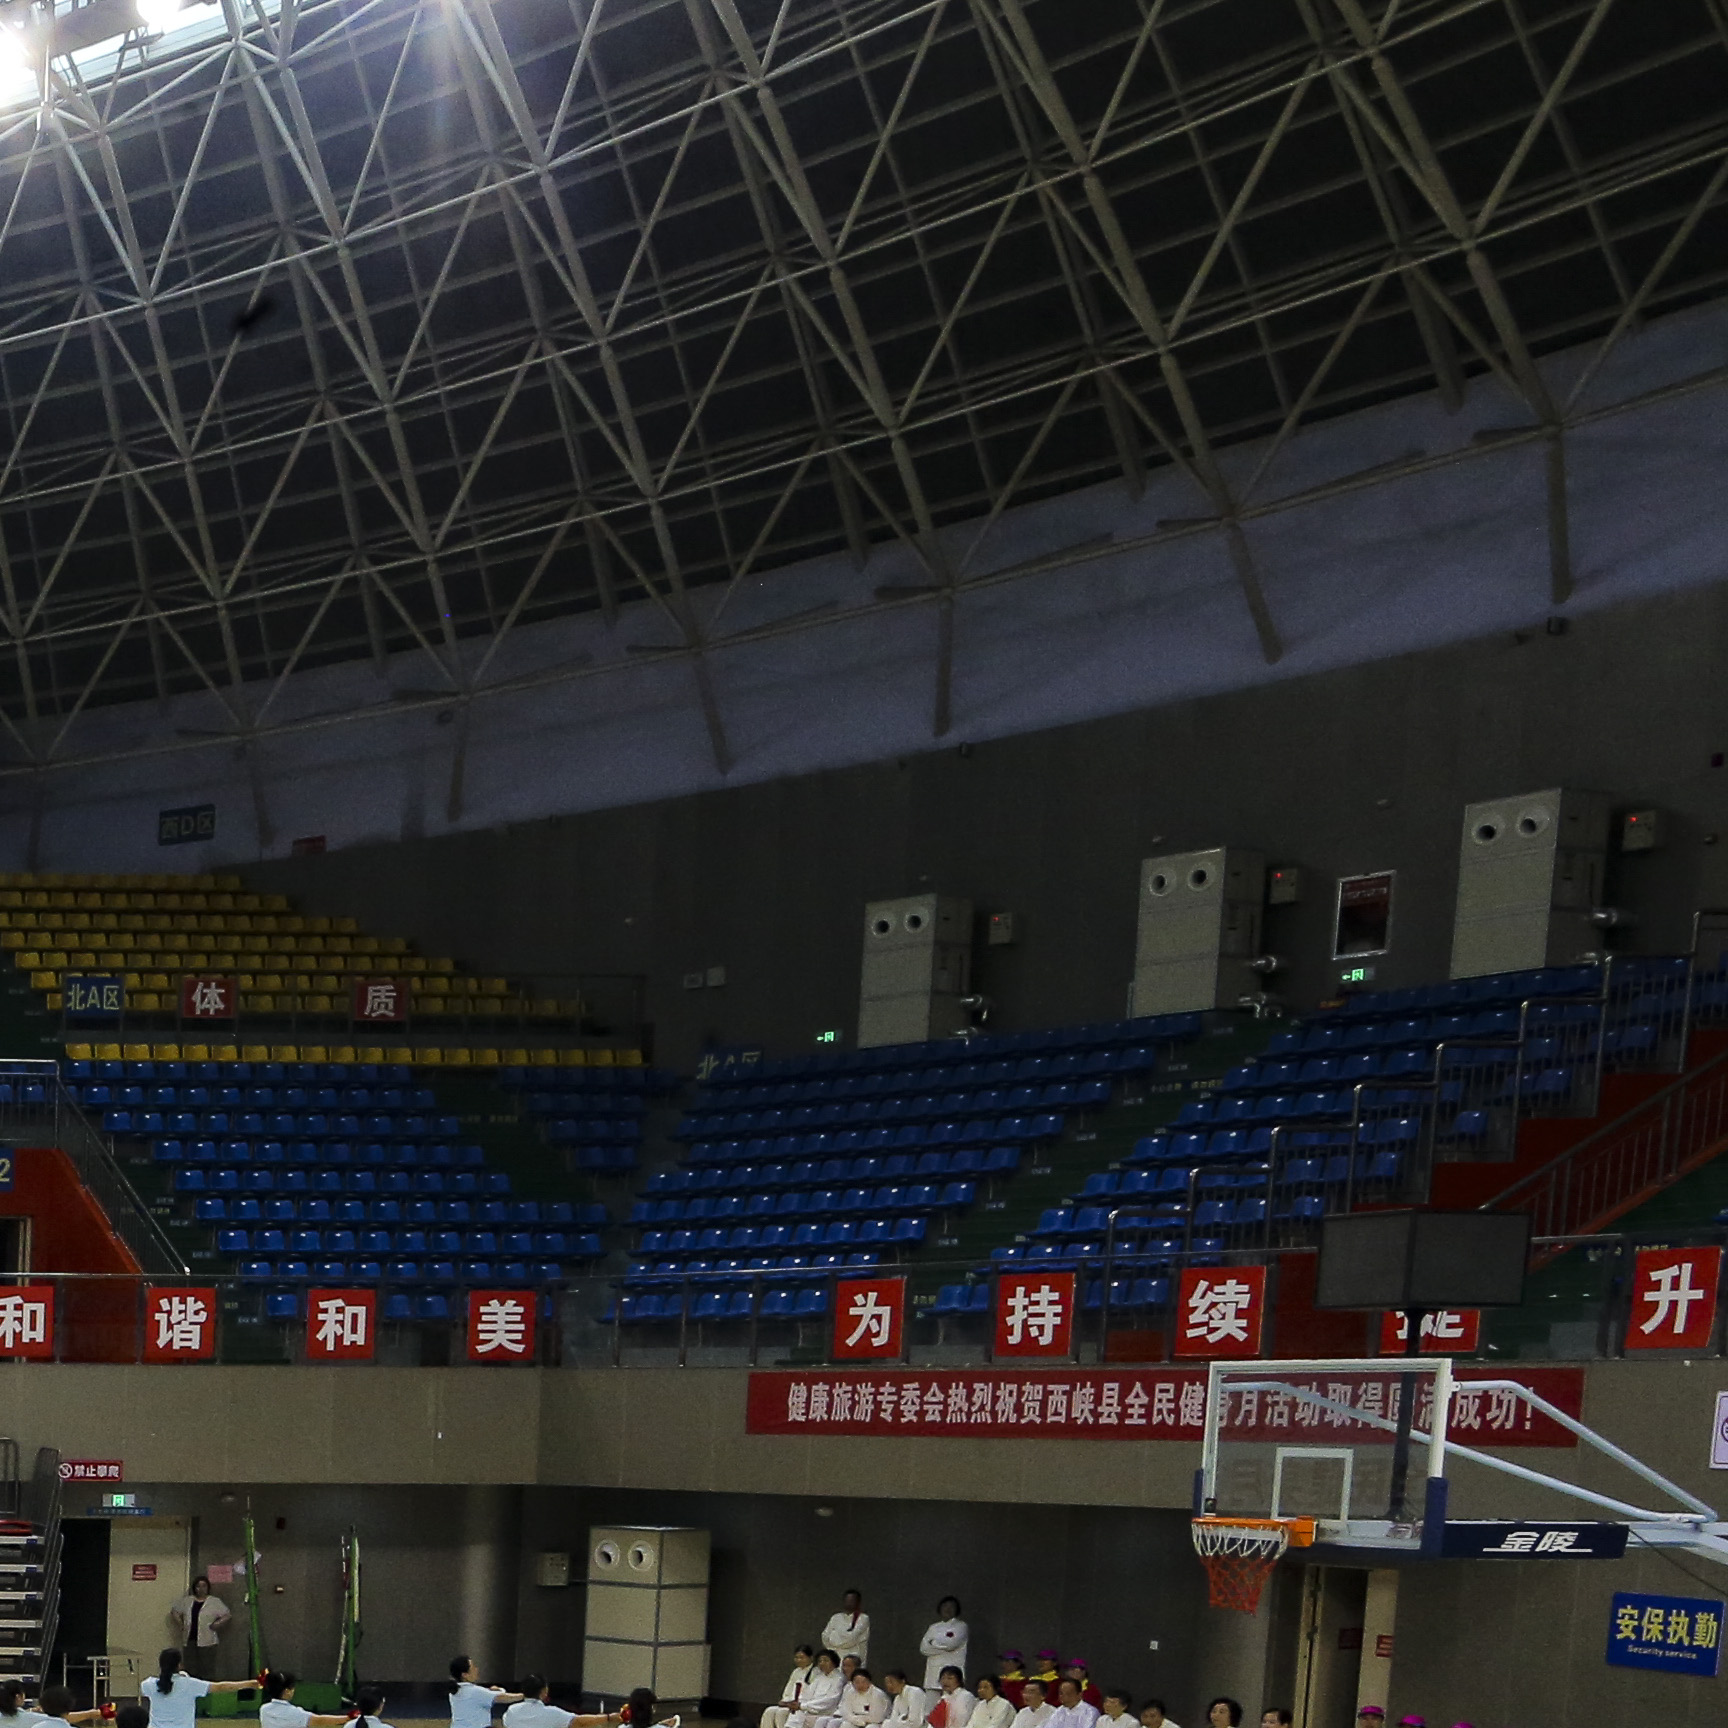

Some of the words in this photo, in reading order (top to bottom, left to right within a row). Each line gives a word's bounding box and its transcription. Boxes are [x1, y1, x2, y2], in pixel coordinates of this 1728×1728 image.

[68, 983, 120, 1011] 北A区
[192, 982, 225, 1015] 体
[364, 984, 397, 1017] 质
[154, 1297, 208, 1349] 谐
[316, 1299, 367, 1351] 和
[476, 1300, 526, 1353] 美
[846, 1291, 891, 1347] 为
[1006, 1285, 1063, 1346] 持
[1186, 1279, 1251, 1344] 续
[1640, 1262, 1704, 1335] 升
[1616, 1605, 1718, 1648] 安保执勤
